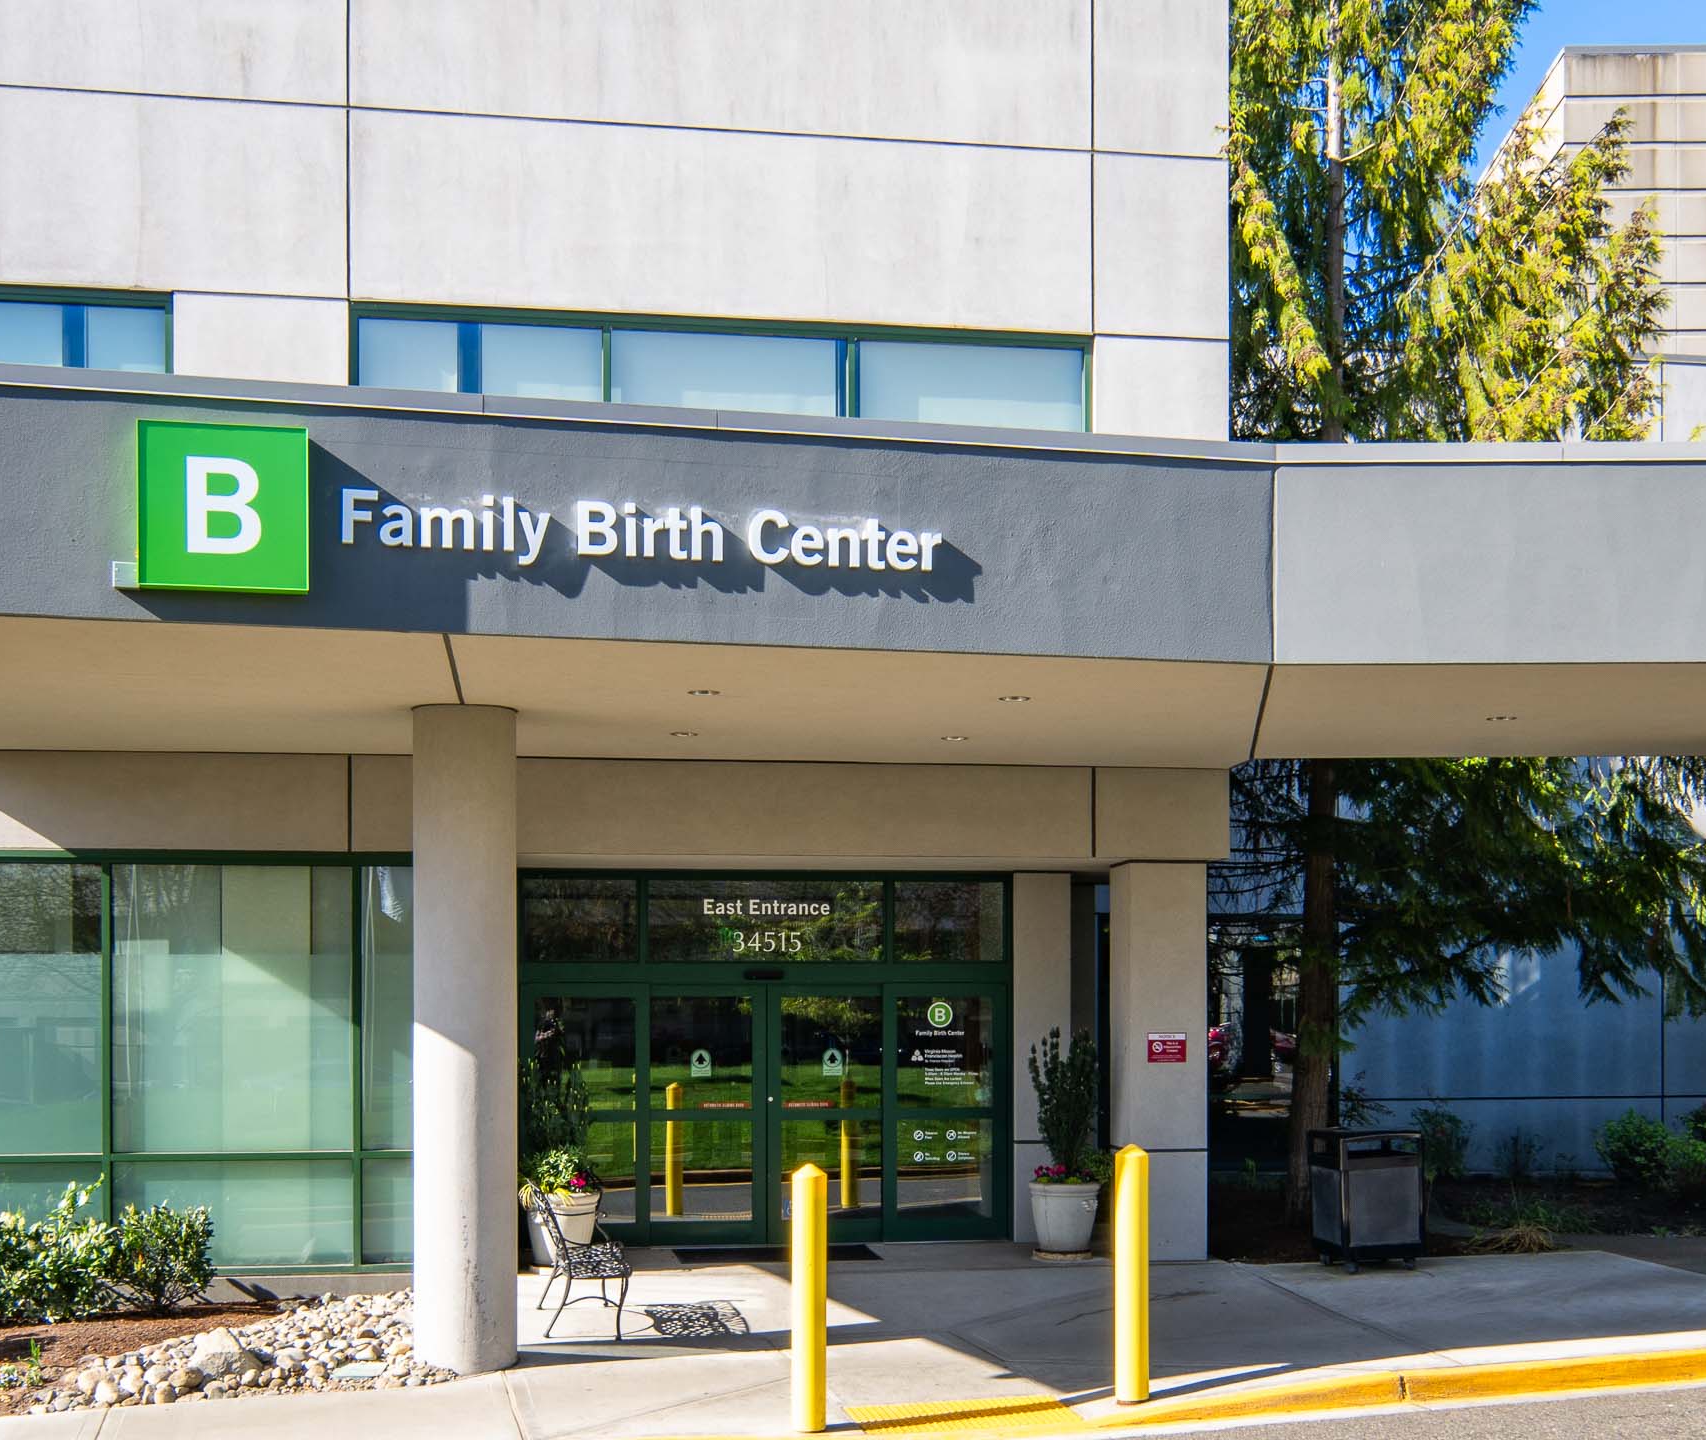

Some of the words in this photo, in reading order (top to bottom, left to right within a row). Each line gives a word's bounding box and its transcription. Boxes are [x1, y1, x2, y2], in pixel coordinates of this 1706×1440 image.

[185, 455, 262, 555] B
[341, 487, 551, 567] Family
[576, 499, 724, 563] Birth
[747, 508, 943, 573] Center
[703, 898, 743, 915] East
[749, 898, 831, 915] Entrance
[732, 931, 802, 952] 34515
[934, 1007, 946, 1022] B
[915, 1029, 933, 1037] Family
